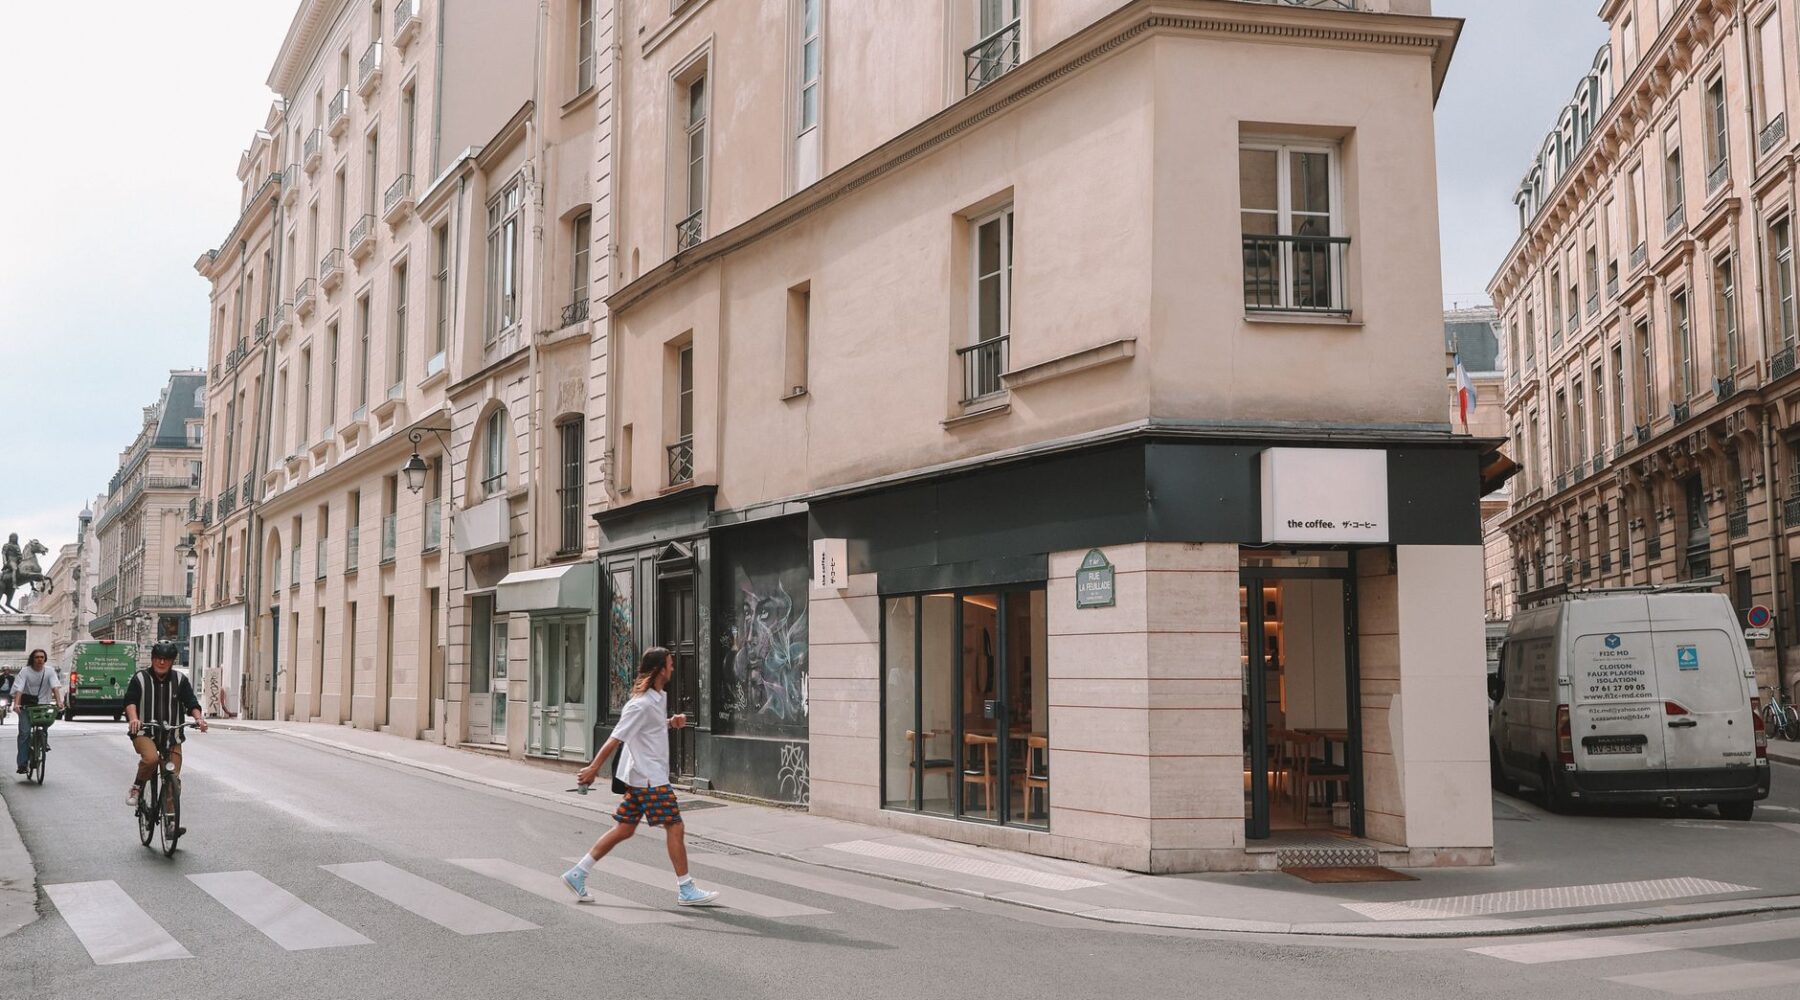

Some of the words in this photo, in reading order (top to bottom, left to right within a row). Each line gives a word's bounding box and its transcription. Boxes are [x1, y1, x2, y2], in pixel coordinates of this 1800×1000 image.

[1288, 520, 1303, 528] the
[1305, 520, 1335, 528] coffee.
[1088, 572, 1100, 580] RUE
